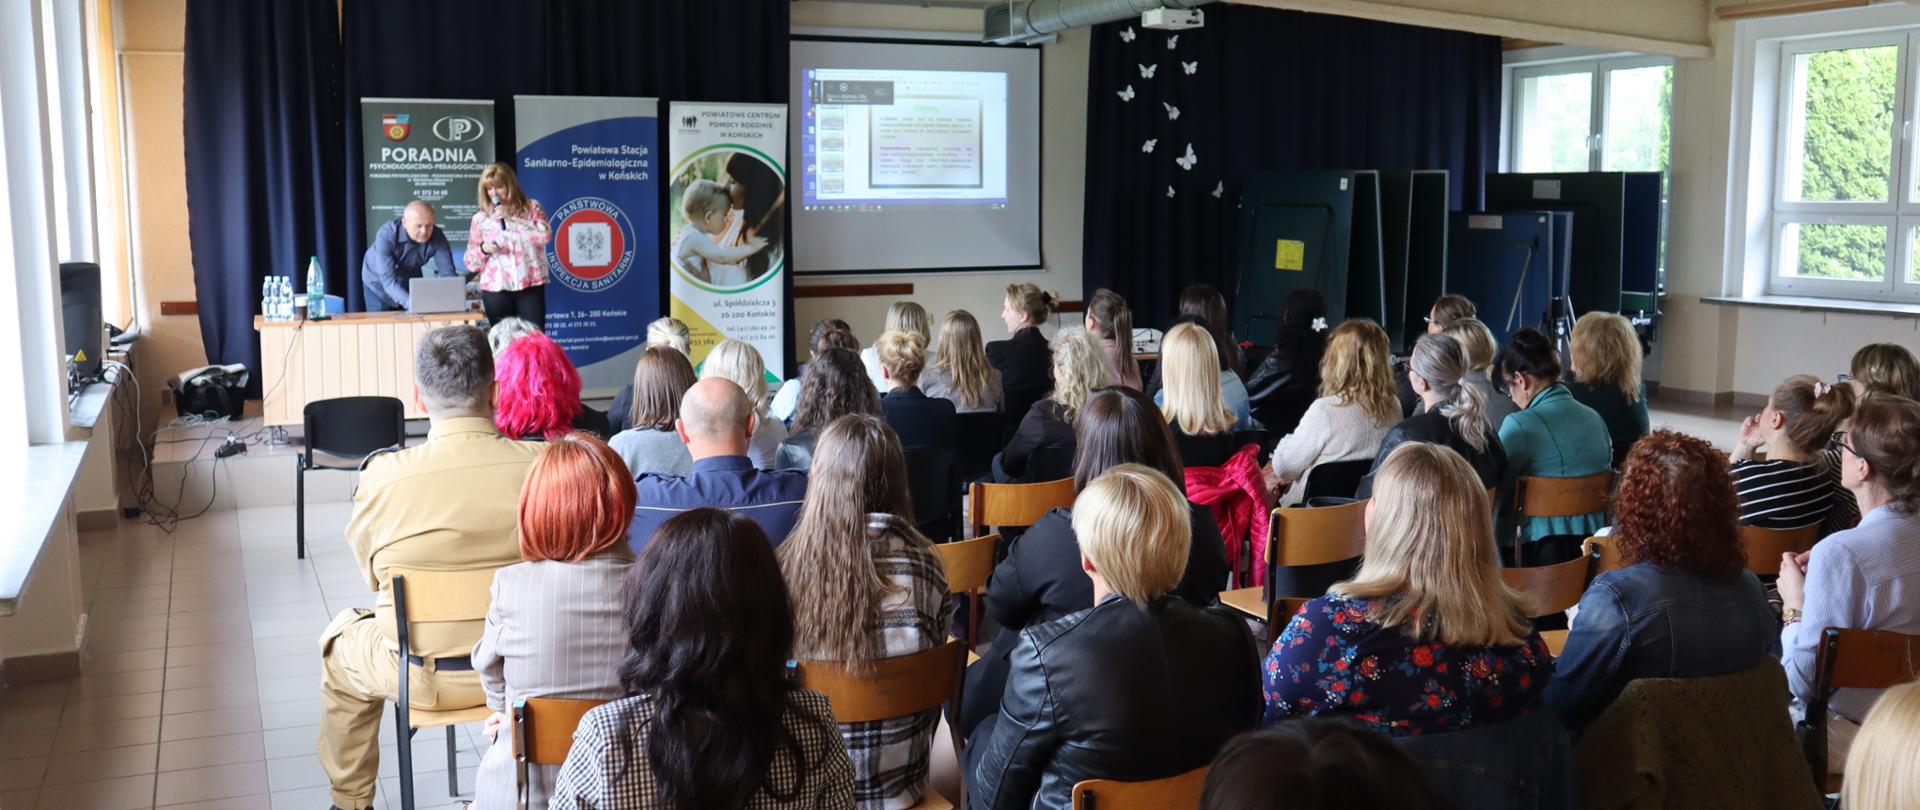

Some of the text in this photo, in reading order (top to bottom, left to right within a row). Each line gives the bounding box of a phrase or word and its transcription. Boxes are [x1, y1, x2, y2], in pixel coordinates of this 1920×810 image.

[381, 147, 477, 162] PORADNIA
[571, 144, 648, 156] Powiatowa Stacja
[524, 158, 648, 169] Sanitarno-Epidemiologiczna
[608, 170, 648, 180] Końskich
[557, 199, 619, 220] PAŃSTWOWA
[547, 250, 633, 289] INSPEKCJA SANITARNA
[724, 299, 770, 308] Spółdzielcza
[602, 309, 627, 317] Końskie
[721, 311, 745, 319] 26-200
